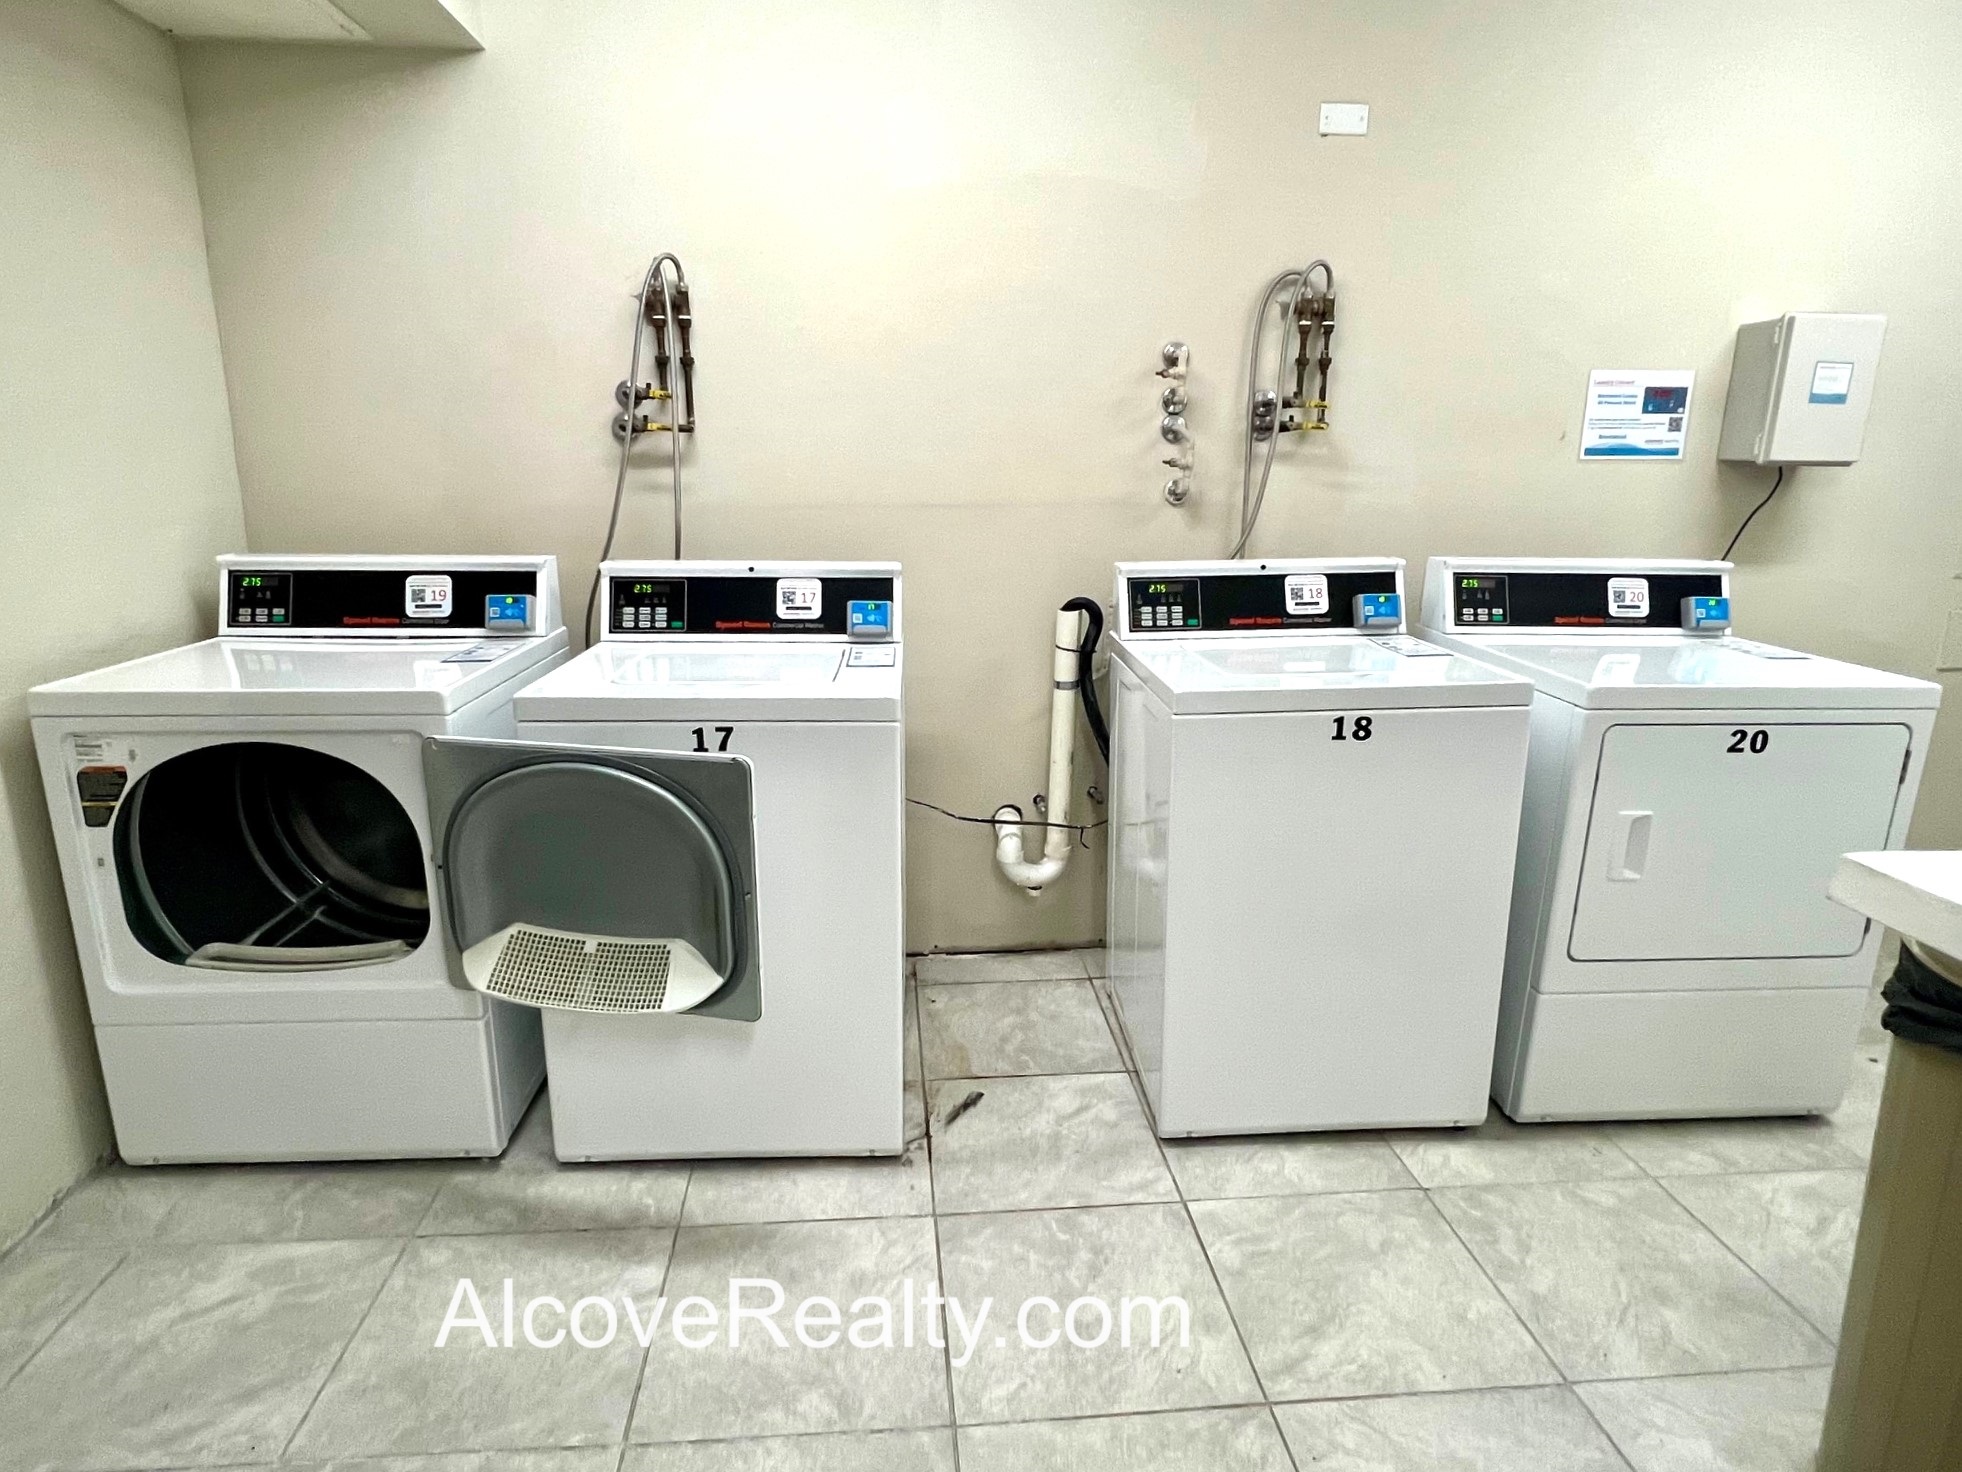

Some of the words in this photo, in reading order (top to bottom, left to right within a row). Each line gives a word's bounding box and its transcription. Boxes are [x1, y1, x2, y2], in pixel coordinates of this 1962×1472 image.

[430, 590, 447, 602] 19
[801, 592, 816, 604] 17
[1308, 588, 1323, 599] 18
[1629, 591, 1645, 603] 20
[1331, 716, 1372, 741] 18
[692, 727, 734, 752] 17
[1726, 729, 1769, 753] 20
